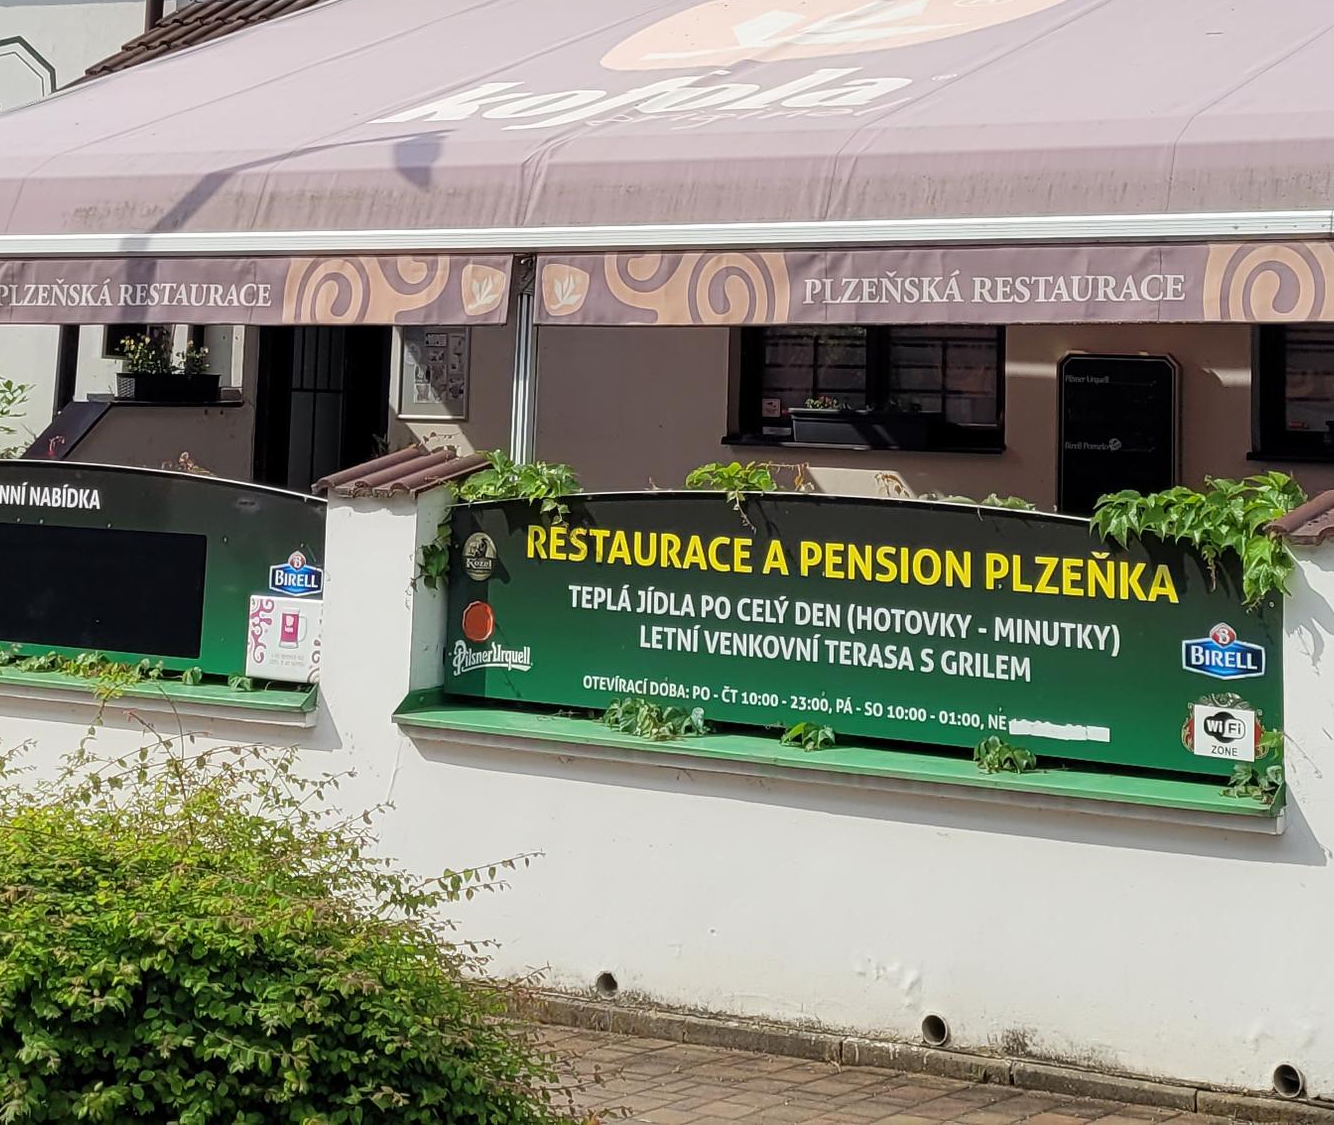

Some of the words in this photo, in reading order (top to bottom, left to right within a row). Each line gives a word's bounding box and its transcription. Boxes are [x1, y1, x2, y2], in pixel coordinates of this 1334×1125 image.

[367, 67, 912, 130] kofola
[118, 282, 272, 307] RESTAURACE
[803, 269, 965, 304] PLZEŇSKÁ
[971, 274, 1186, 304] RESTAURACE
[29, 483, 101, 510] NABÍDKA
[274, 569, 319, 588] BIRELL
[467, 558, 492, 570] Kozel
[527, 524, 753, 574] RESTAURACE
[762, 539, 789, 576] A
[799, 540, 972, 589] PENSION
[984, 550, 1180, 604] PLZEŇKA
[568, 583, 632, 612] TEPLÁ
[636, 586, 696, 618] JÍDLA
[701, 594, 731, 620] PO
[737, 595, 790, 624] CELÝ
[795, 600, 841, 628] DEN
[847, 602, 972, 639] (HOTOVKY
[994, 616, 1120, 657] MINUTKY)
[452, 639, 493, 675] Pilsner
[491, 641, 532, 671] Urquell
[639, 625, 699, 653] LETNÍ
[703, 629, 819, 663] VENKOVNÍ
[824, 638, 915, 672] TERASA
[919, 648, 935, 674] S
[940, 649, 1032, 682] GRILEM
[1190, 645, 1258, 670] BIRELL
[582, 674, 648, 695] OTEVÍRACÍ
[649, 681, 690, 700] DOBA:
[693, 685, 711, 701] PO
[721, 685, 739, 703] ČT
[742, 690, 779, 708] 10:00
[790, 695, 832, 715] 23:00,
[836, 696, 853, 715] PÁ
[864, 701, 883, 717] SO
[887, 705, 927, 723] 10:00
[939, 710, 984, 730] 01:00,
[988, 714, 1007, 731] NE
[1211, 745, 1238, 757] ZONE
